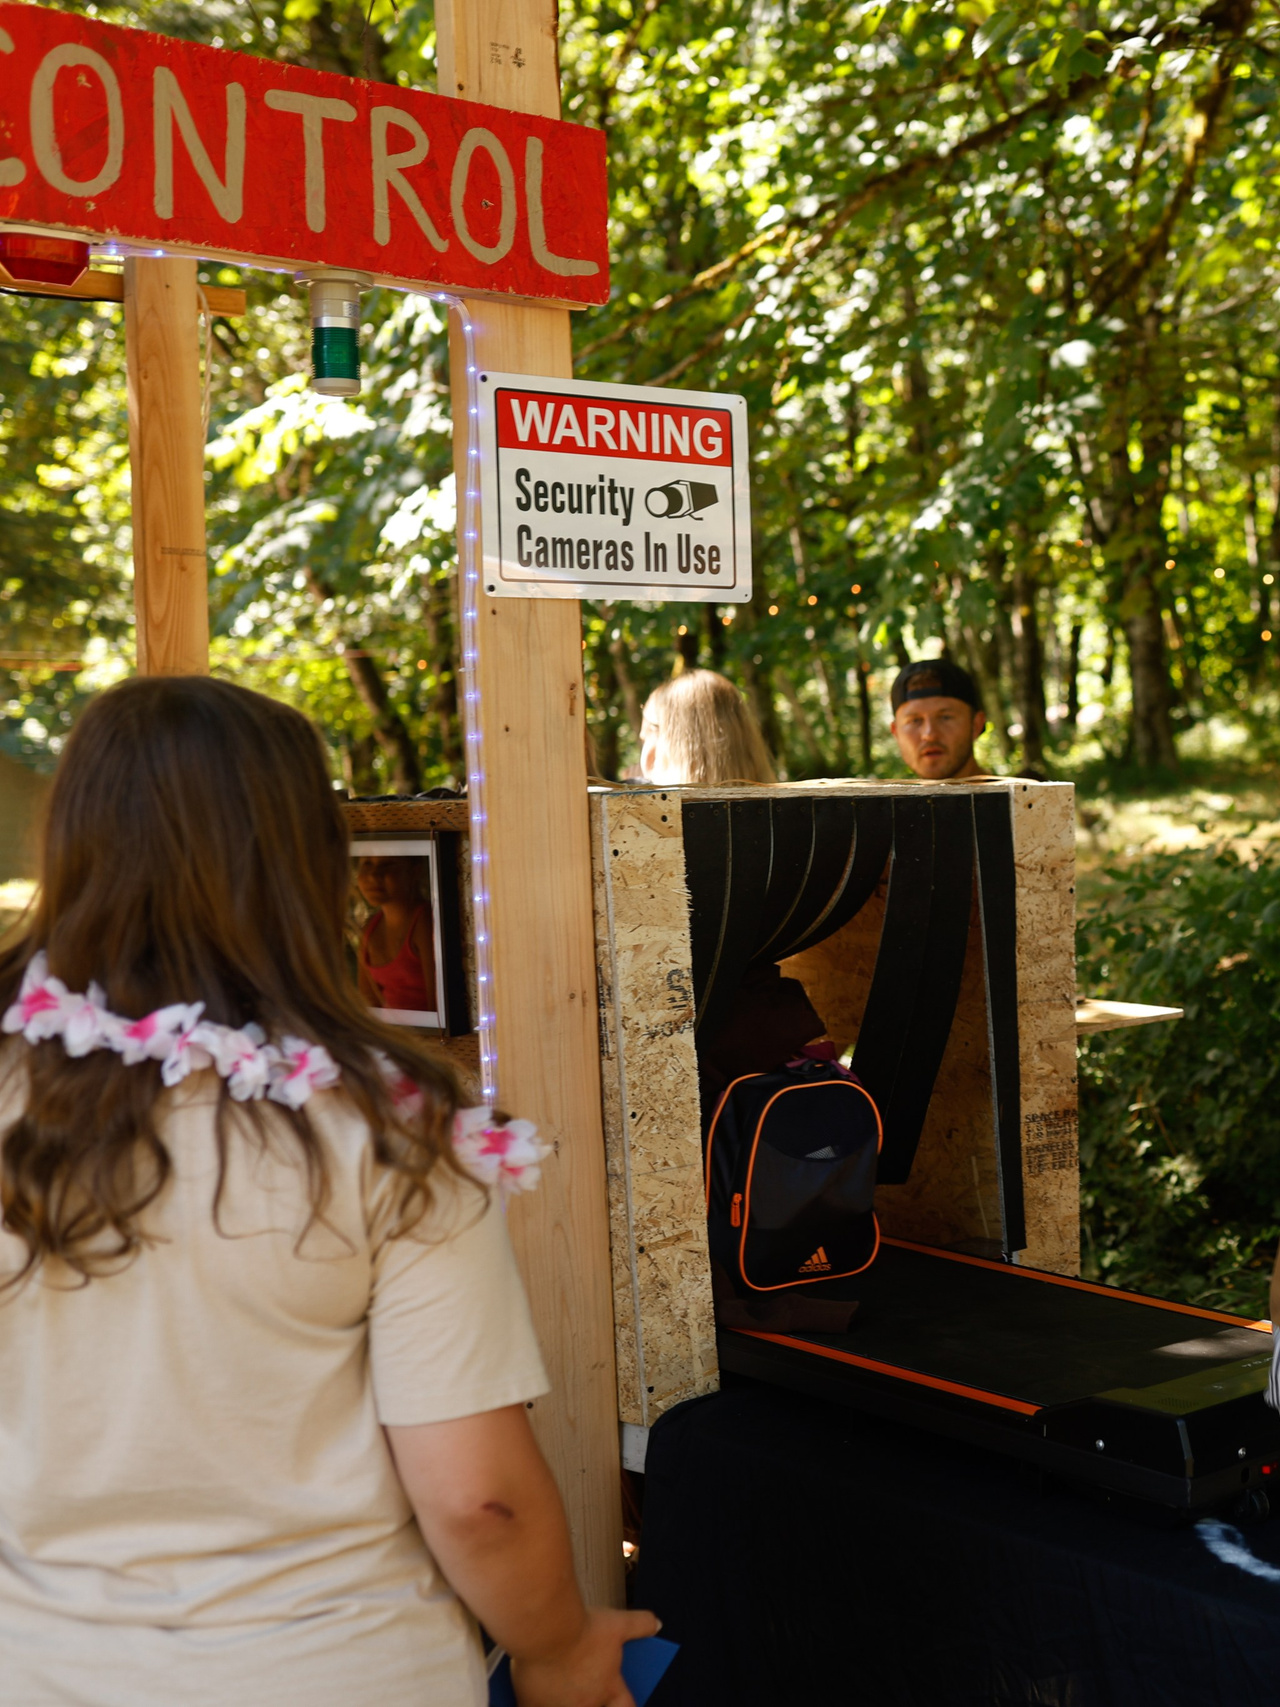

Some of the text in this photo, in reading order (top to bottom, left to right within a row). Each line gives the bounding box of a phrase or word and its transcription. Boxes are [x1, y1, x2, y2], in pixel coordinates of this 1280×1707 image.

[0, 26, 600, 278] ONTROL
[510, 398, 723, 459] WARNING
[515, 467, 634, 526] Security
[517, 524, 721, 575] Cameras In Use
[799, 1263, 831, 1273] adidas
